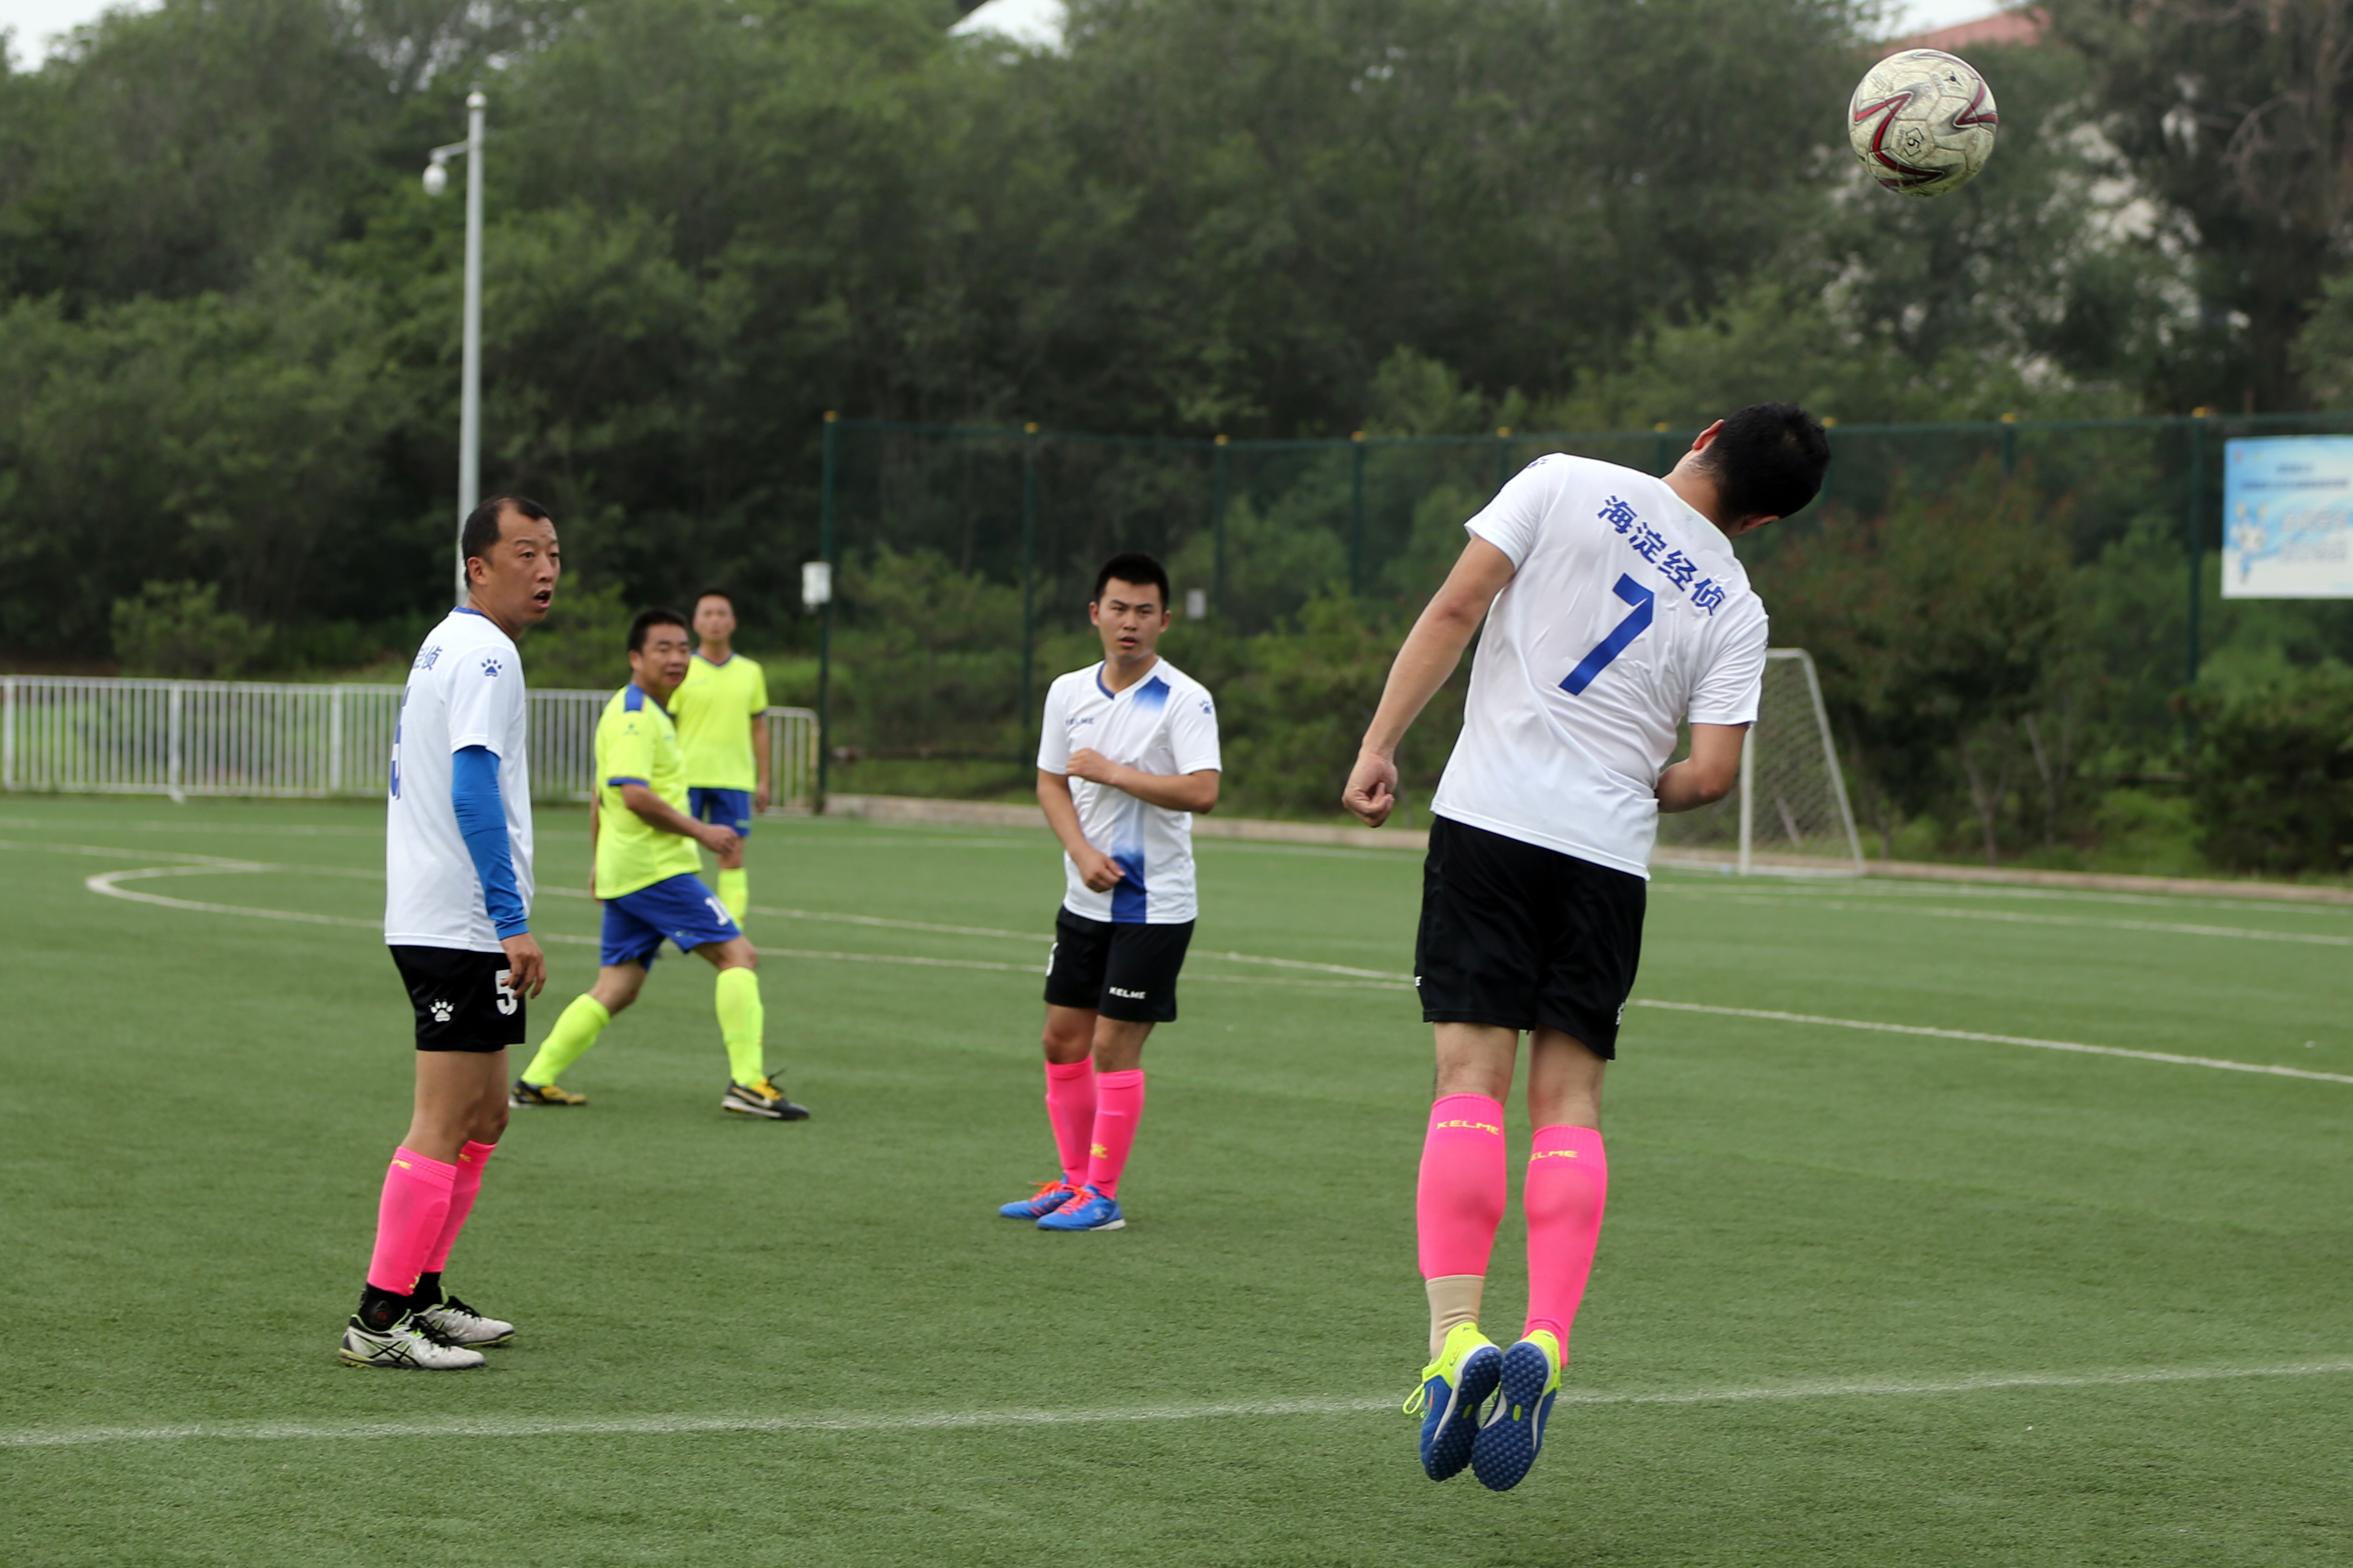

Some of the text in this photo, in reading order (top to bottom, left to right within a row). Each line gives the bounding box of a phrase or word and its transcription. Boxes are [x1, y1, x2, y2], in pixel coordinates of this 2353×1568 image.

[1596, 495, 1726, 616] 海淀经侦
[1559, 573, 1655, 695] 7
[495, 969, 518, 1015] 5
[1109, 986, 1146, 999] KELME
[1437, 1120, 1500, 1135] KELME
